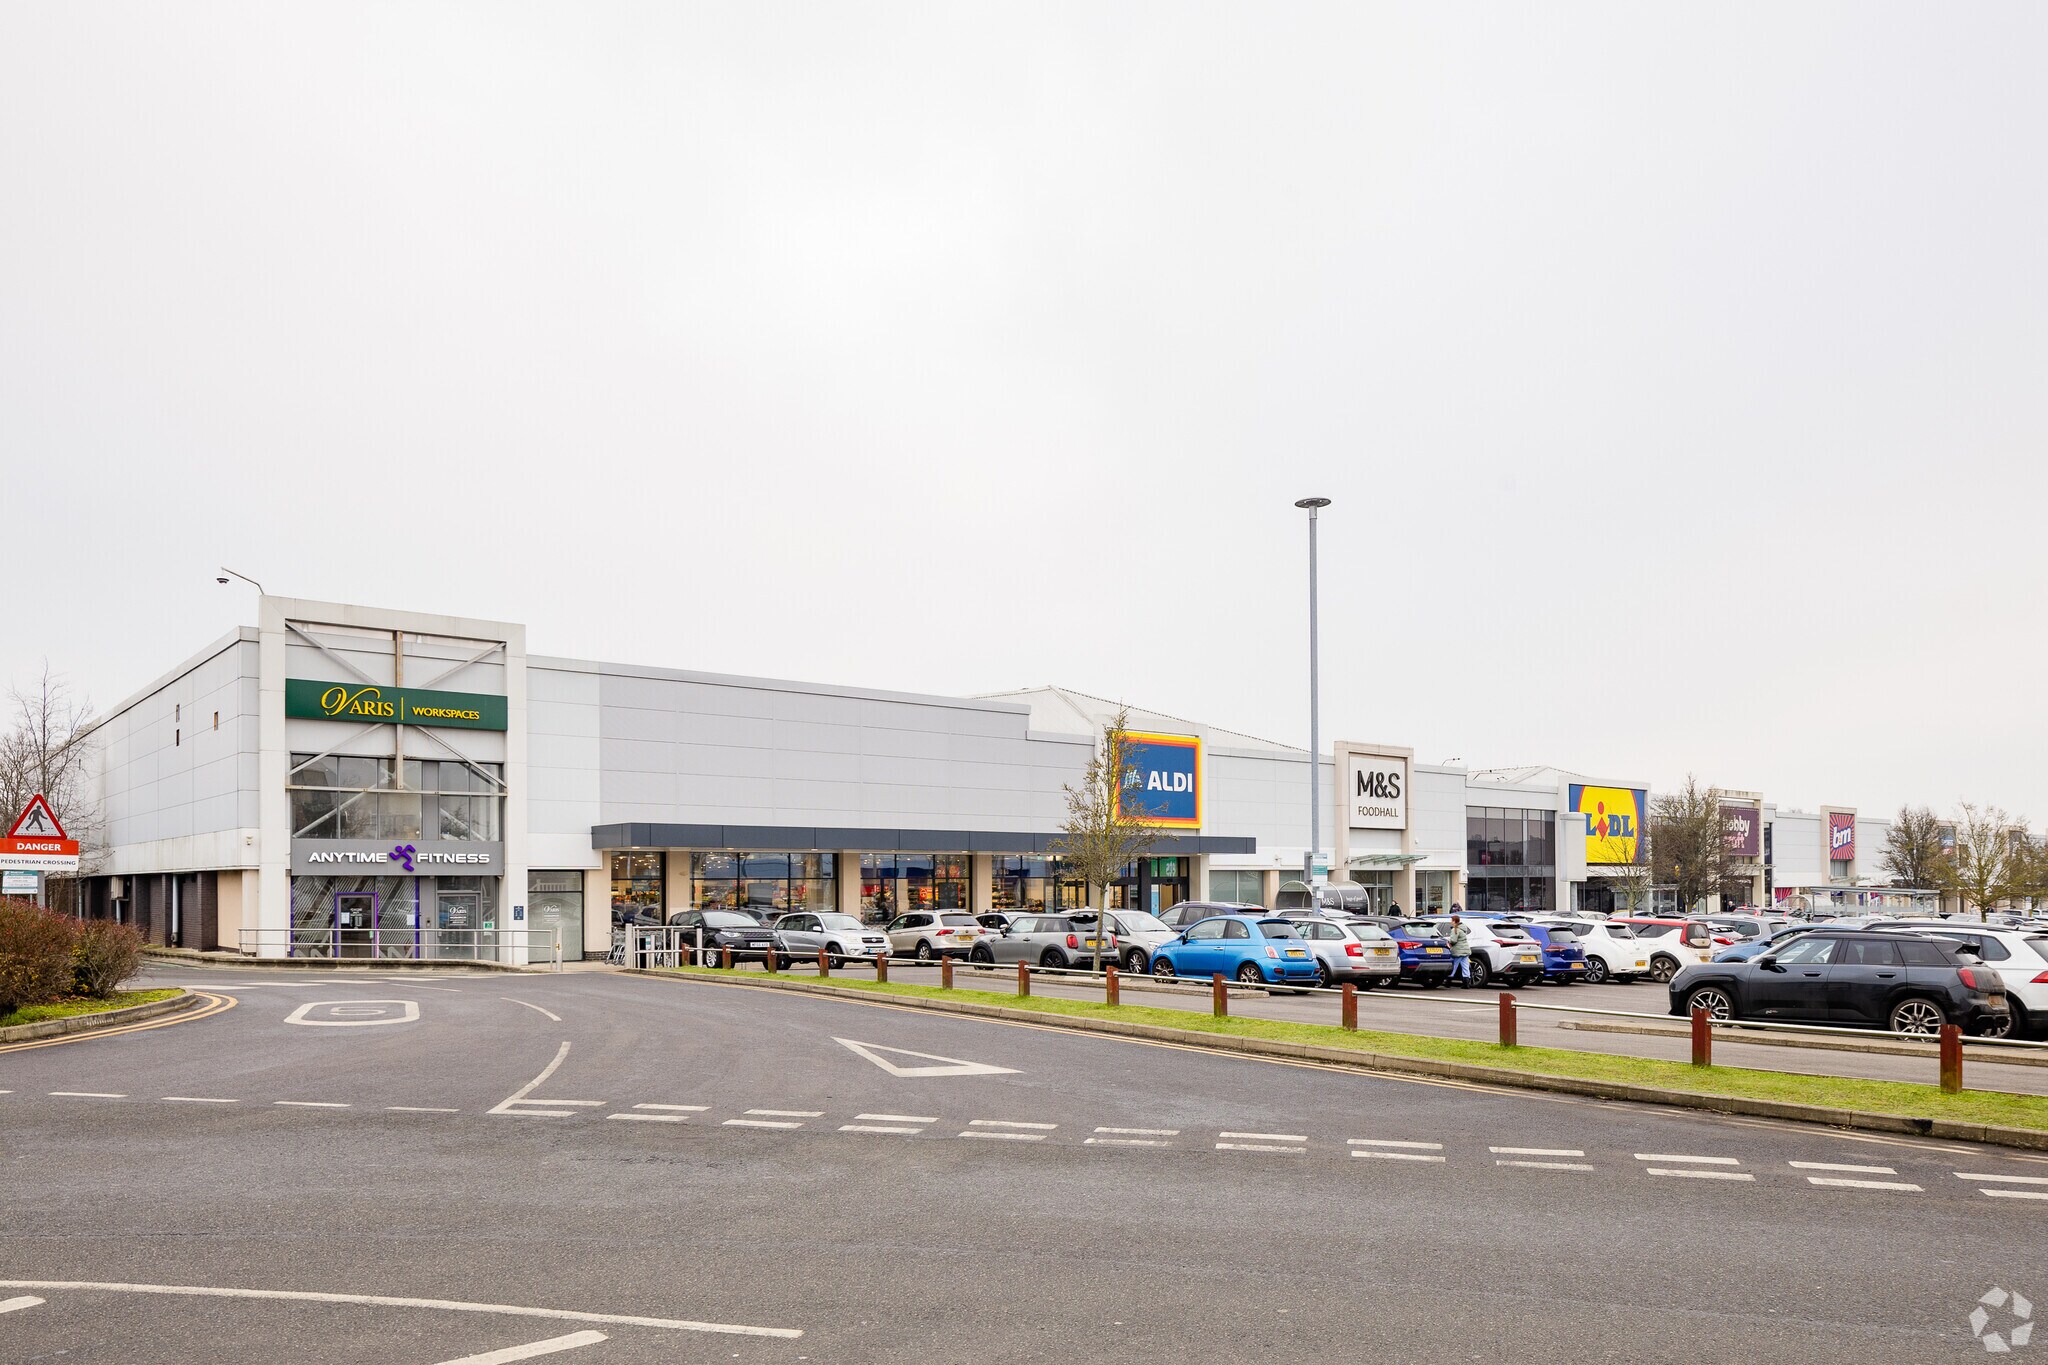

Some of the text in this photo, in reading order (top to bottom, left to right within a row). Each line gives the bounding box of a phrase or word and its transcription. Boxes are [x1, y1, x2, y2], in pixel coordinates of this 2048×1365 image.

[412, 706, 480, 720] WORKSPACES
[1147, 770, 1193, 793] ALDI
[1357, 770, 1401, 799] M&S
[1358, 806, 1399, 817] FOODHALL
[16, 842, 61, 851] DANGER
[308, 852, 490, 864] ANYTIME FITNESS
[1321, 897, 1335, 906] M&S
